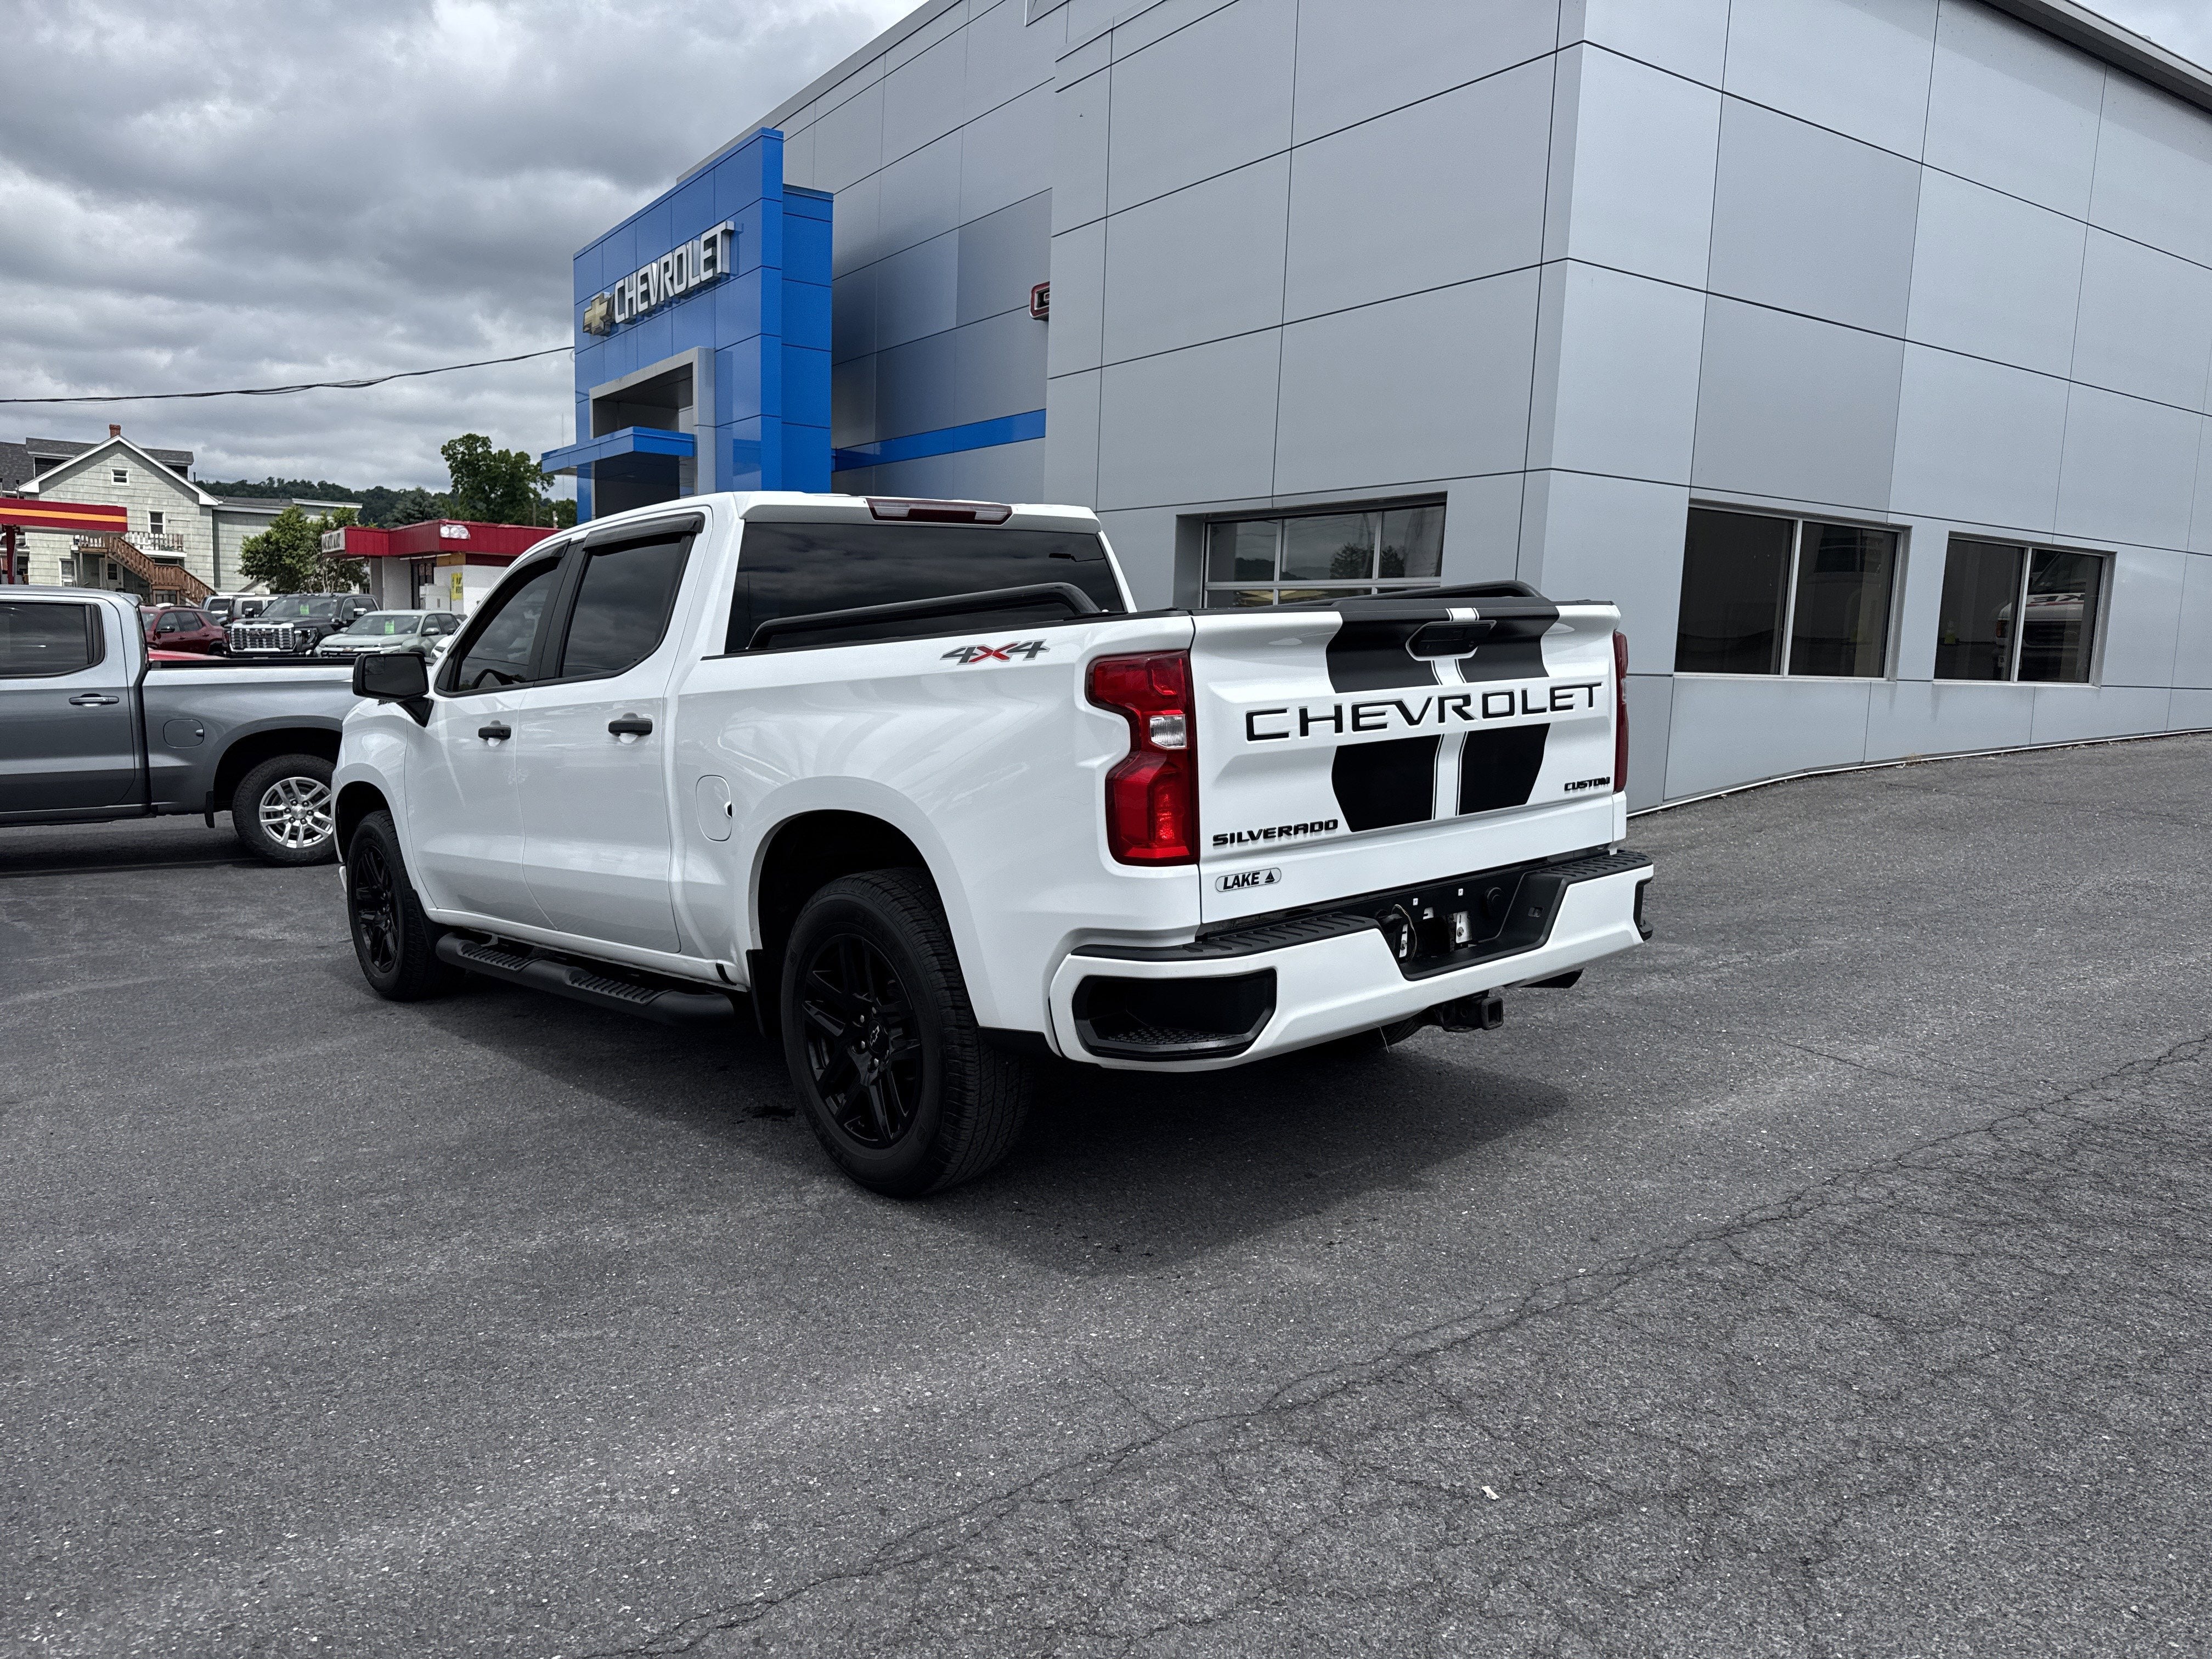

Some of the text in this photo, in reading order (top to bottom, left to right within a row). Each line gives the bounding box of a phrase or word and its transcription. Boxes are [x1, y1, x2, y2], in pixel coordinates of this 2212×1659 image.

[615, 220, 735, 324] CHEVROLET
[1245, 681, 1602, 742] CHEVROLET
[1564, 776, 1610, 791] CUSTOM
[1213, 819, 1338, 846] SILVERADO
[1223, 871, 1261, 890] LAKE
